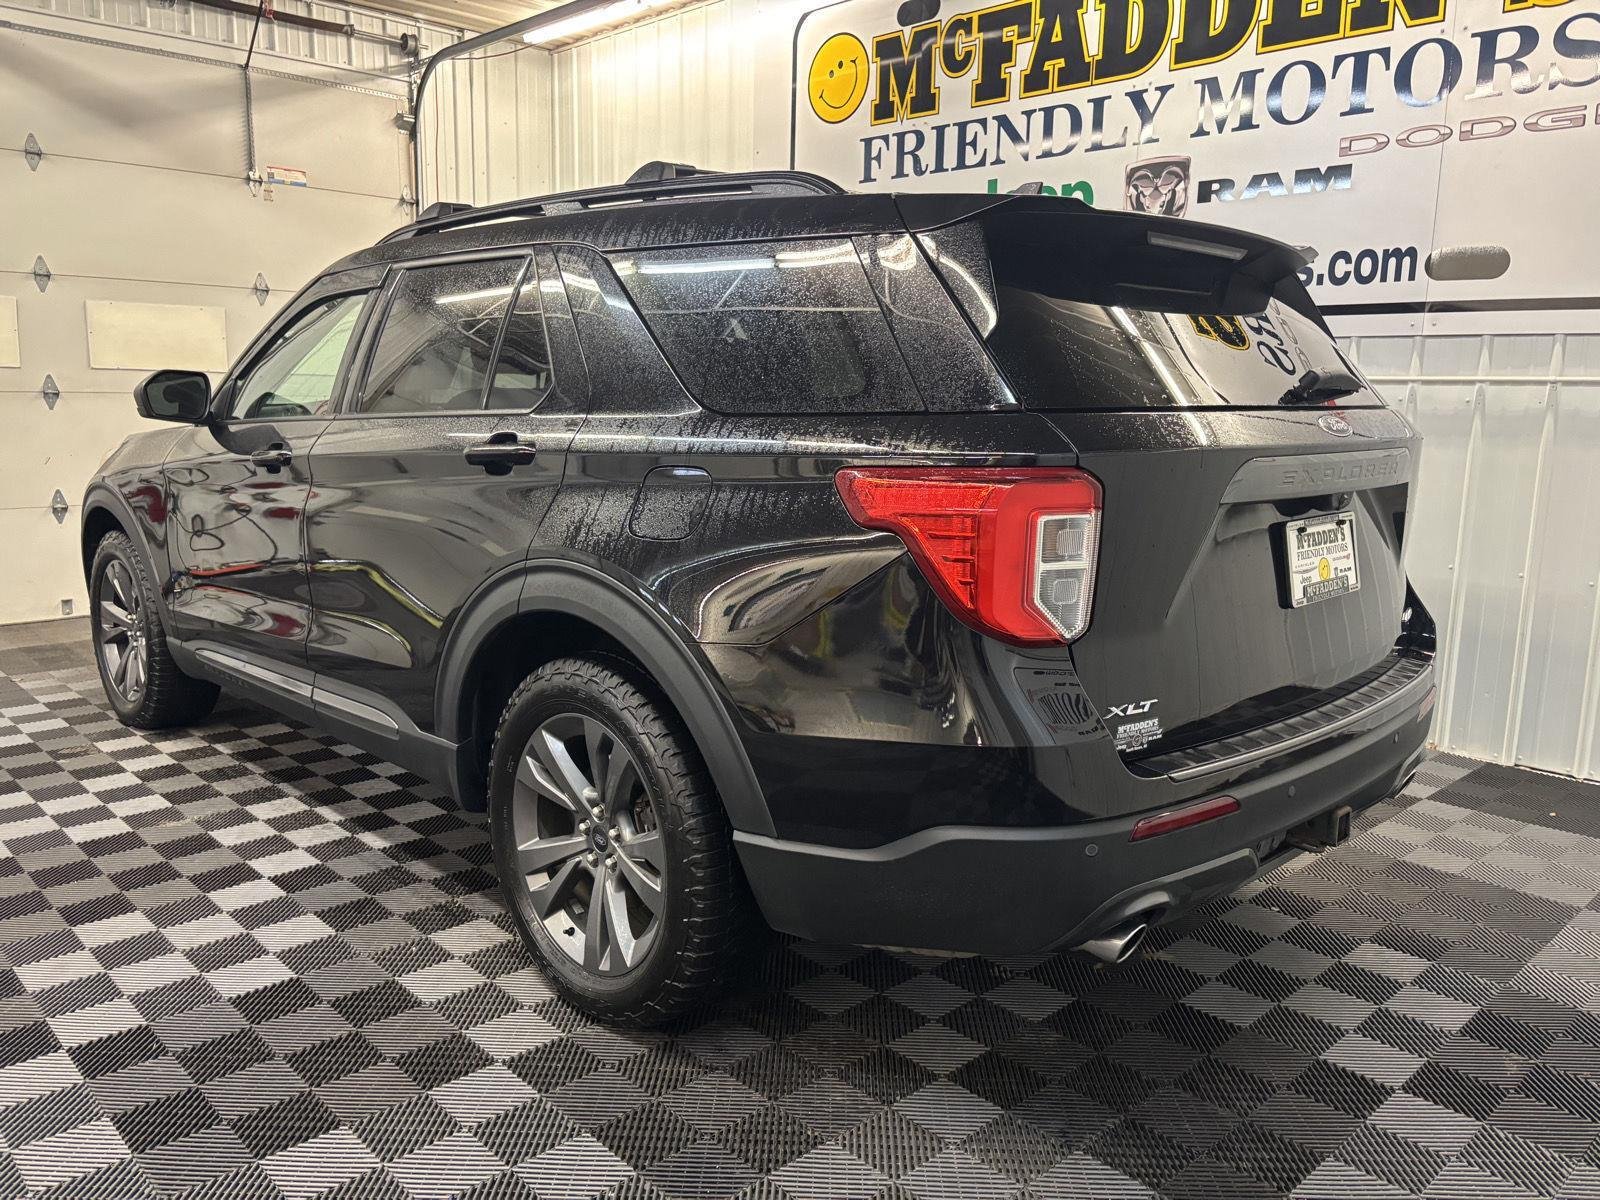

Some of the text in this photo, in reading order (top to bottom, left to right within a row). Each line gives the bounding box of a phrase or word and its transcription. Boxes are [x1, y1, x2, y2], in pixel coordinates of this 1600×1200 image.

[858, 12, 1600, 184] FRIENDLY MOTORS
[1338, 103, 1600, 157] DODG
[1196, 164, 1353, 203] RAM
[1282, 461, 1399, 487] EXPLORER
[1102, 698, 1159, 720] XLT
